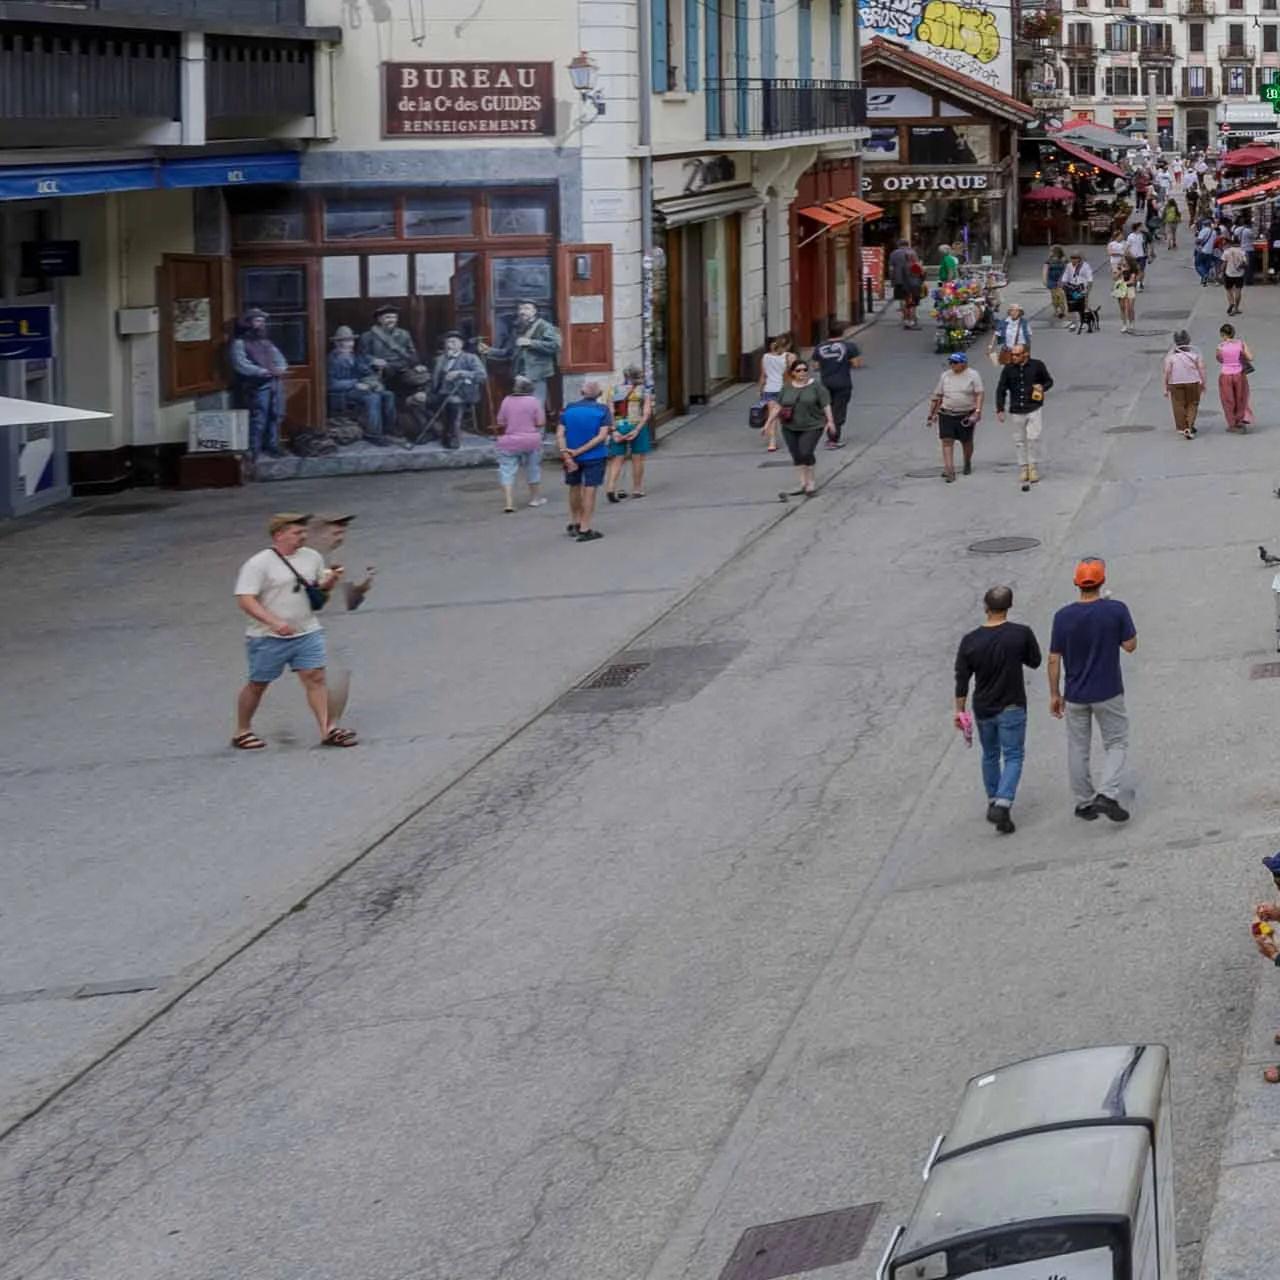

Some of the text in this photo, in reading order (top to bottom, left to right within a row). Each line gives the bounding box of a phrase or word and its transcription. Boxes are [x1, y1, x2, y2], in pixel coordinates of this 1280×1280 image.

[400, 68, 537, 89] BUREAU
[398, 96, 416, 111] de
[418, 96, 432, 111] la
[454, 96, 479, 111] des
[480, 95, 542, 112] GUIDES
[403, 119, 537, 133] RENSEIGNEMENTS
[883, 175, 988, 191] OPTIQUE
